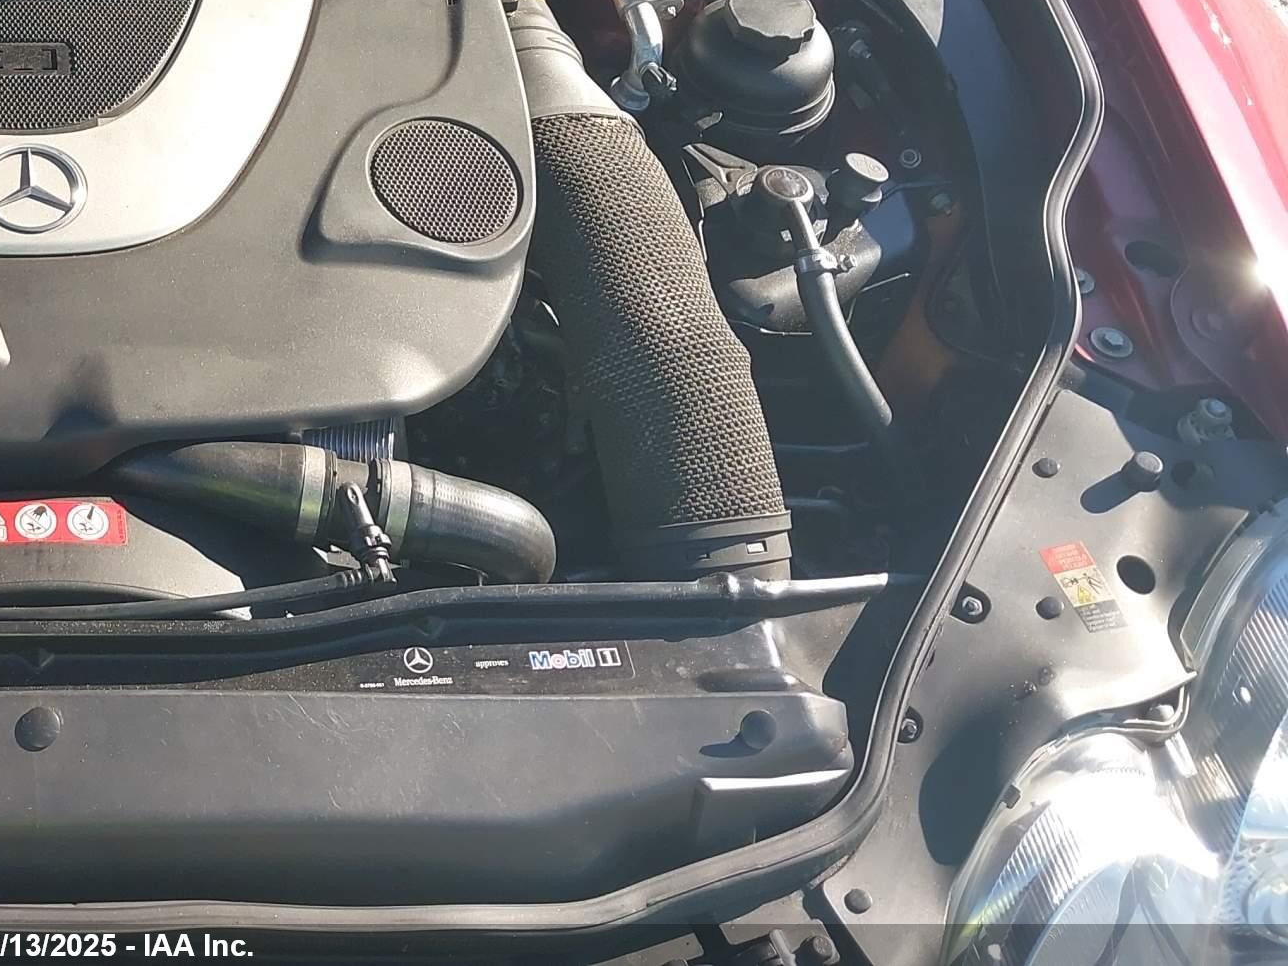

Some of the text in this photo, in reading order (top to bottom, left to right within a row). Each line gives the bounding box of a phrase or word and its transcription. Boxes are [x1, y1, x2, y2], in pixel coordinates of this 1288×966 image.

[475, 659, 509, 668] approves
[529, 649, 595, 670] Mobil
[394, 676, 453, 687] Mercedes-Benz
